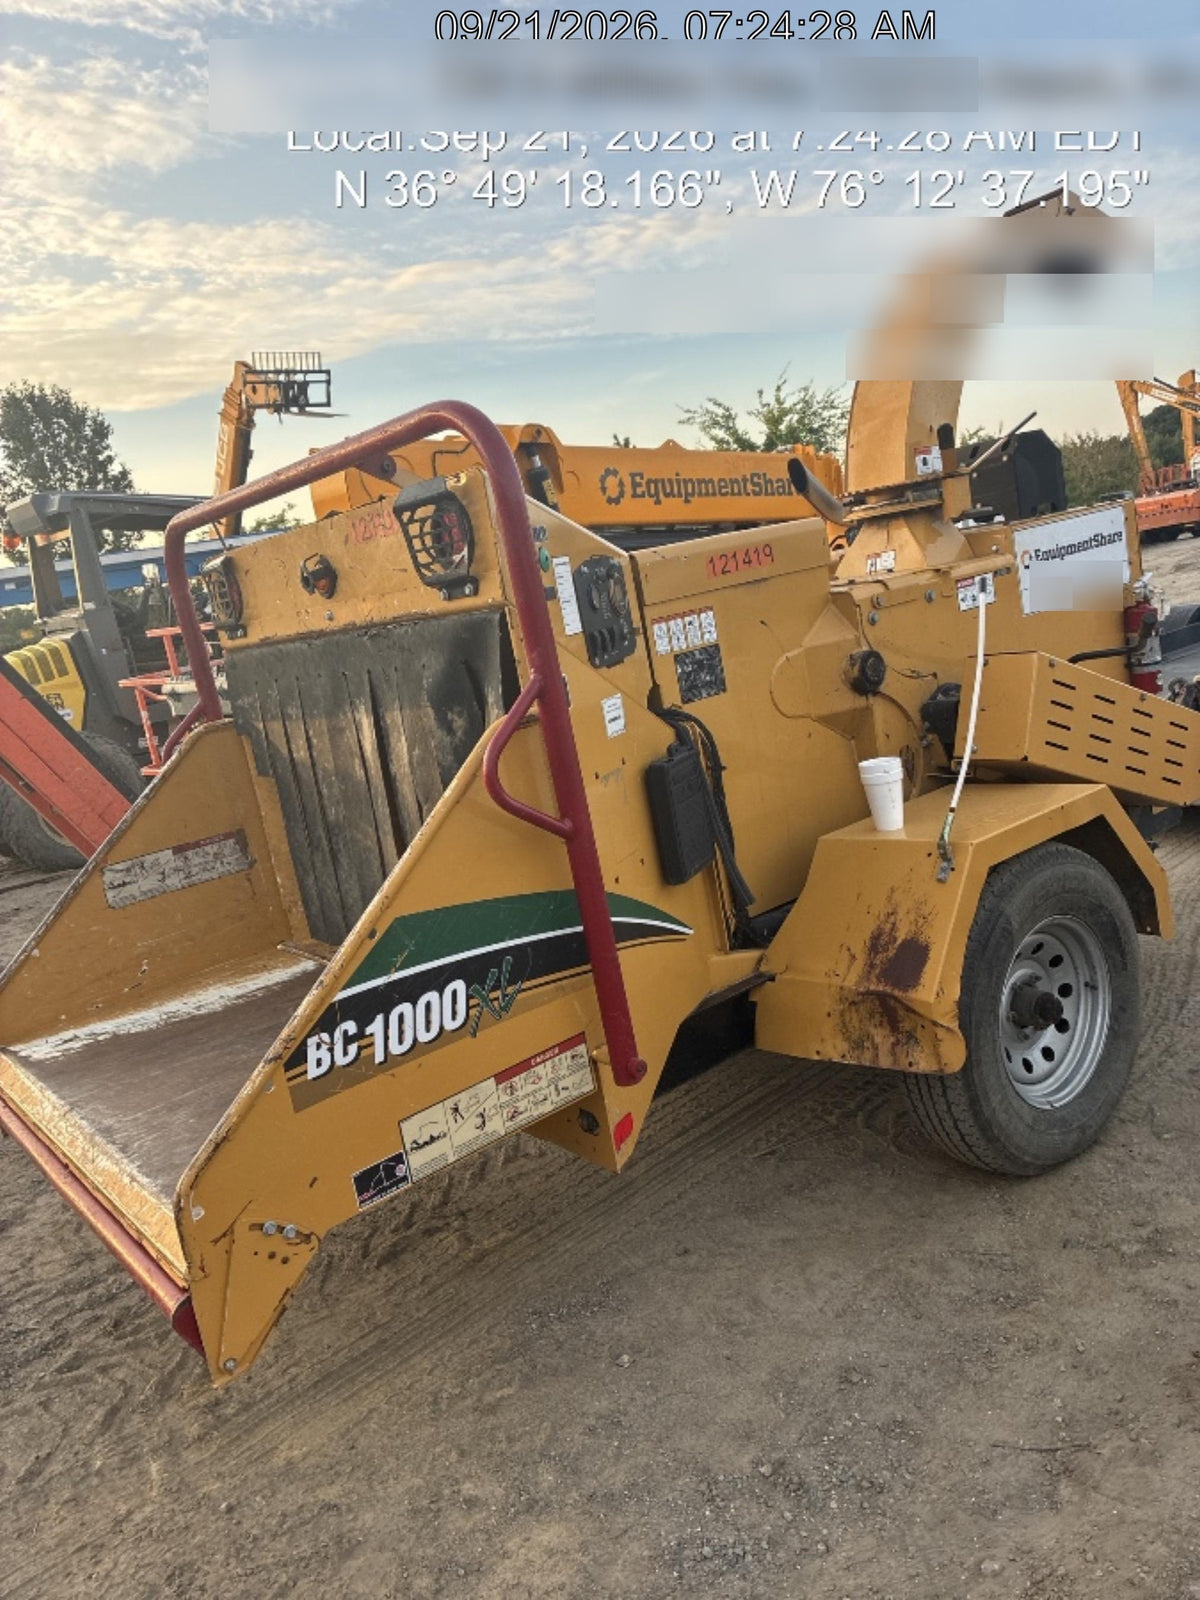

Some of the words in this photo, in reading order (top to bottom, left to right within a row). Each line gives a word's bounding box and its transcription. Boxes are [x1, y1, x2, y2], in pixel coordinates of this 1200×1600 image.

[629, 472, 800, 505] EquipmentShar
[708, 543, 775, 577] 121419
[1034, 531, 1123, 561] EquipmentShare
[306, 1019, 360, 1081] BC
[365, 979, 468, 1065] 1000
